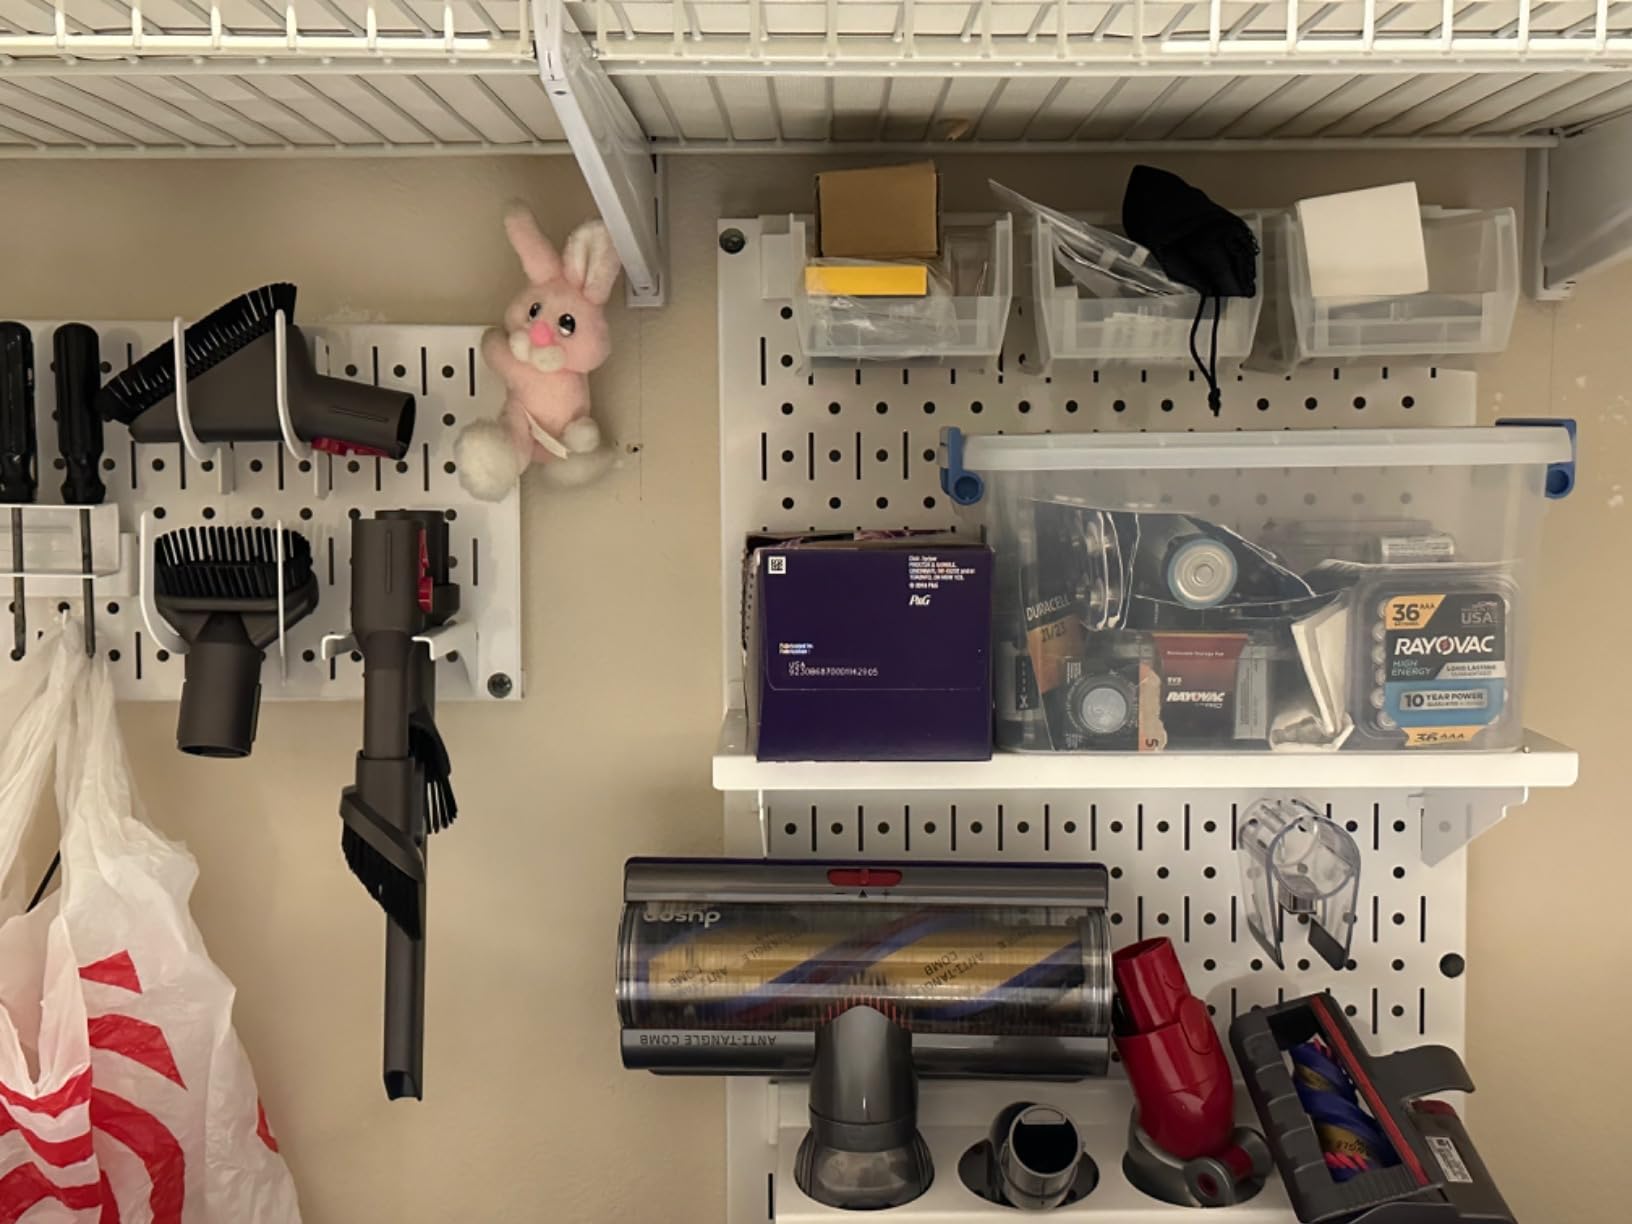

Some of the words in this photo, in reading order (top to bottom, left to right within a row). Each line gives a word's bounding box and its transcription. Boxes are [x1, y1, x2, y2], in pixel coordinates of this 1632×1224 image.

[909, 594, 931, 606] P&G
[1025, 594, 1072, 621] DURACELL
[1392, 604, 1420, 621] 36
[1461, 611, 1493, 624] USA
[1394, 635, 1496, 655] RAYOVAC
[1391, 667, 1432, 677] ENERGY
[1166, 691, 1226, 703] RAYOVAC
[1405, 694, 1424, 708] 10
[1426, 693, 1451, 701] YEAR
[1451, 692, 1484, 700] POWER
[1416, 732, 1438, 742] 36
[639, 1033, 680, 1044] COMB
[685, 1034, 777, 1047] ANTI-TANGLE
